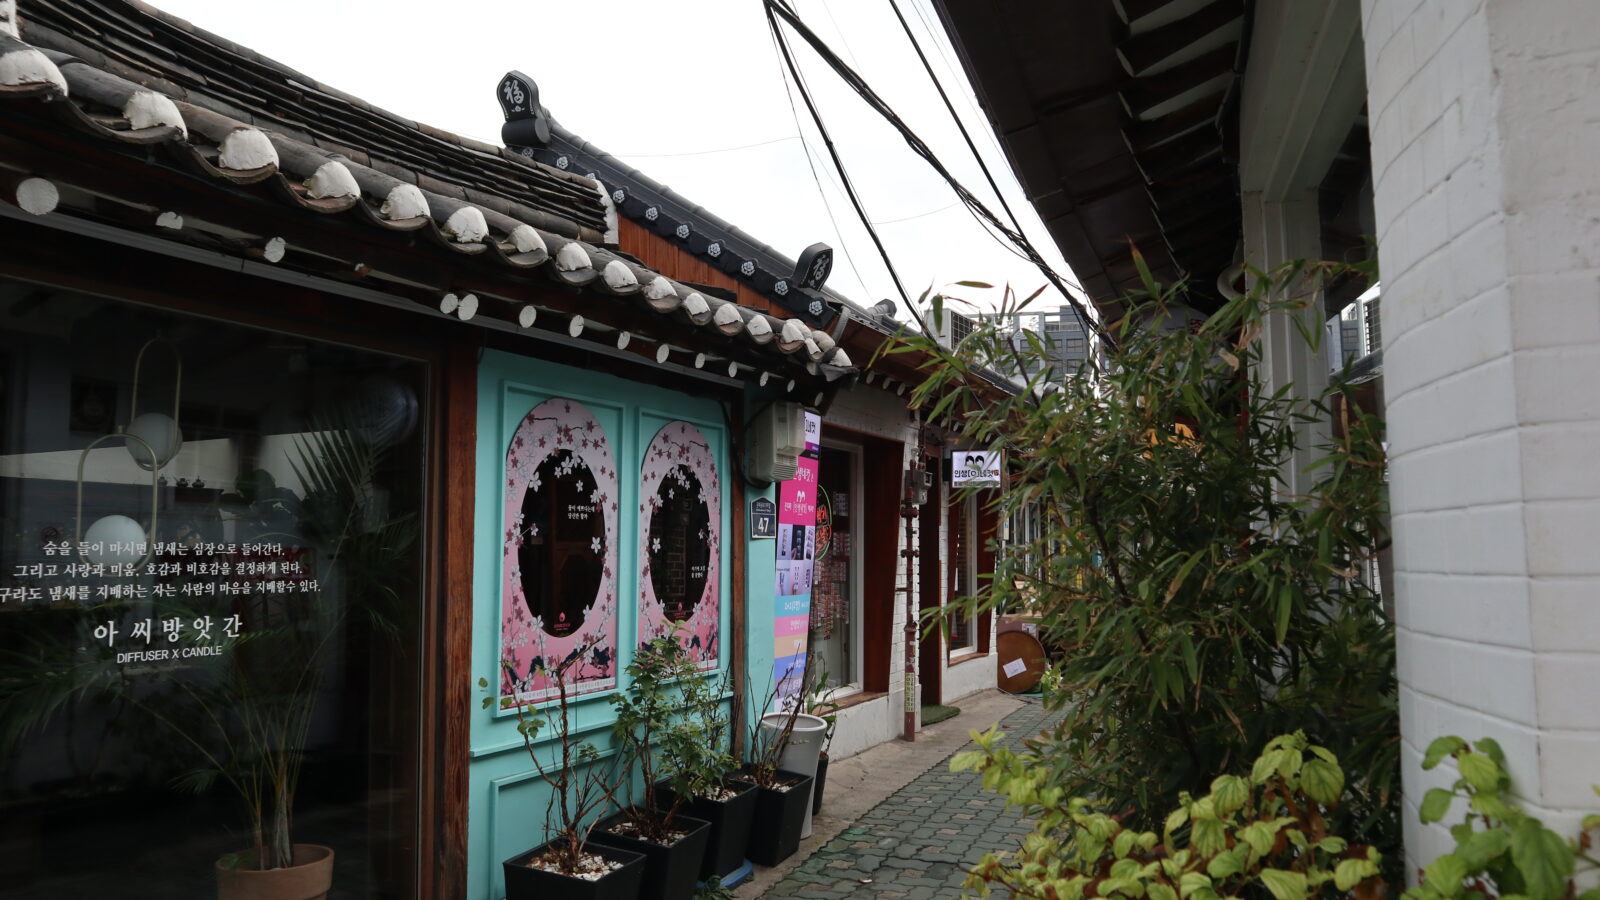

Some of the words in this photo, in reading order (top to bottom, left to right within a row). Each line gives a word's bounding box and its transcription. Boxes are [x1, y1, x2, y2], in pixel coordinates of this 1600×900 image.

[758, 517, 770, 533] 47
[43, 541, 72, 556] 숨을
[77, 541, 104, 556] 들이
[110, 541, 148, 556] 마시면
[153, 542, 189, 556] 냄새는
[193, 542, 238, 556] 심장으로
[241, 543, 285, 556] 들어간다.
[13, 563, 59, 578] 그리고
[63, 563, 105, 578] 사랑과
[145, 562, 182, 577] 호감과
[187, 562, 231, 576] 비호감을
[235, 562, 276, 575] 결정하게
[280, 561, 303, 574] 된다.
[49, 585, 91, 601] 냄새를
[96, 584, 148, 599] 지배하는
[152, 583, 177, 597] 자는
[181, 582, 215, 596] 사람의
[219, 581, 251, 595] 마음을
[299, 580, 321, 592] 있다.
[117, 650, 169, 664] DIFFUSER
[171, 649, 180, 659] X
[182, 645, 223, 658] CANDLE
